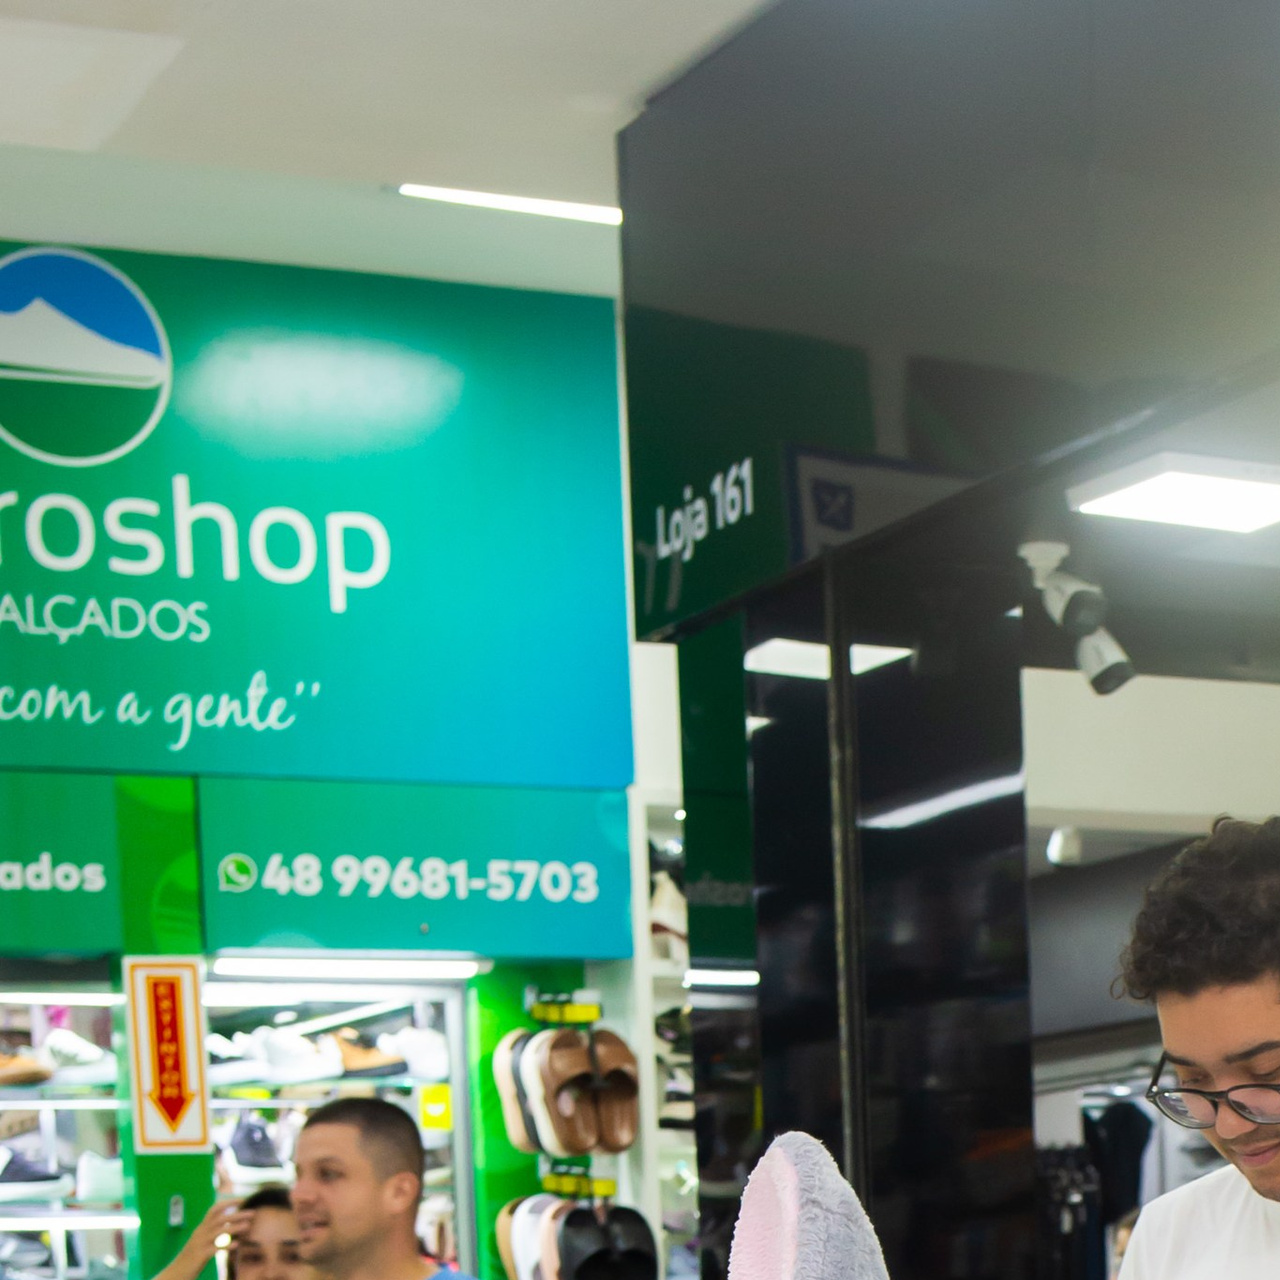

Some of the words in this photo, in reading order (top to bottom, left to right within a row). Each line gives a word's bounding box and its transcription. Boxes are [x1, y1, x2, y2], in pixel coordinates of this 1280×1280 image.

[657, 484, 708, 563] Loja
[710, 457, 753, 529] 161
[0, 593, 211, 645] ALÇADOS
[0, 684, 103, 724] com
[117, 692, 151, 725] a
[0, 851, 106, 893] ados
[261, 852, 324, 897] 48
[331, 854, 600, 904] 99681-5703
